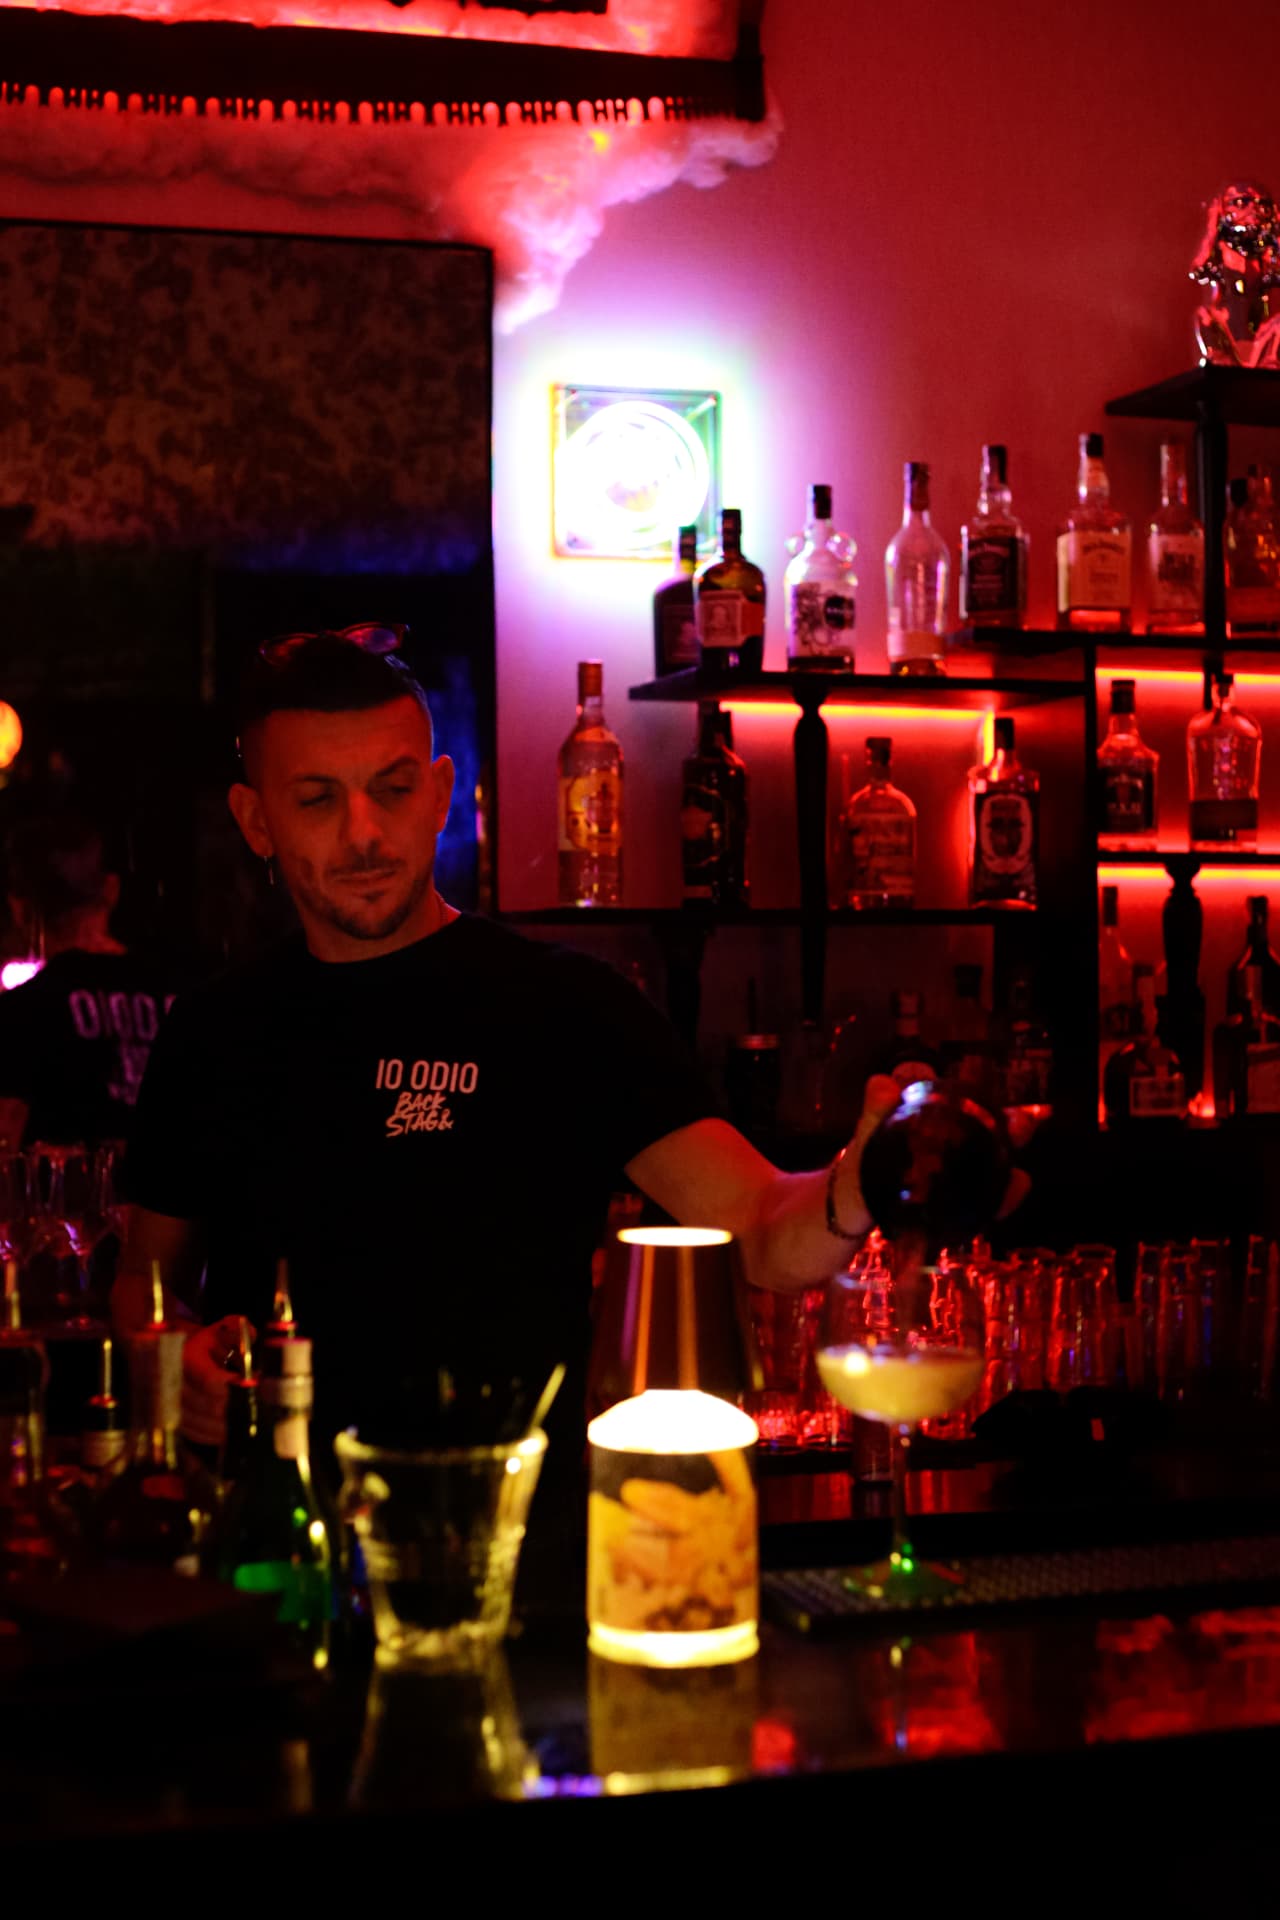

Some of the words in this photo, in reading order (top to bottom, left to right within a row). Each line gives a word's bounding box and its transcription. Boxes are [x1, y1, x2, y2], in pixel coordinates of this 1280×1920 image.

[375, 1058, 404, 1090] IO
[410, 1060, 479, 1094] ODIO
[394, 1091, 447, 1115] BACK
